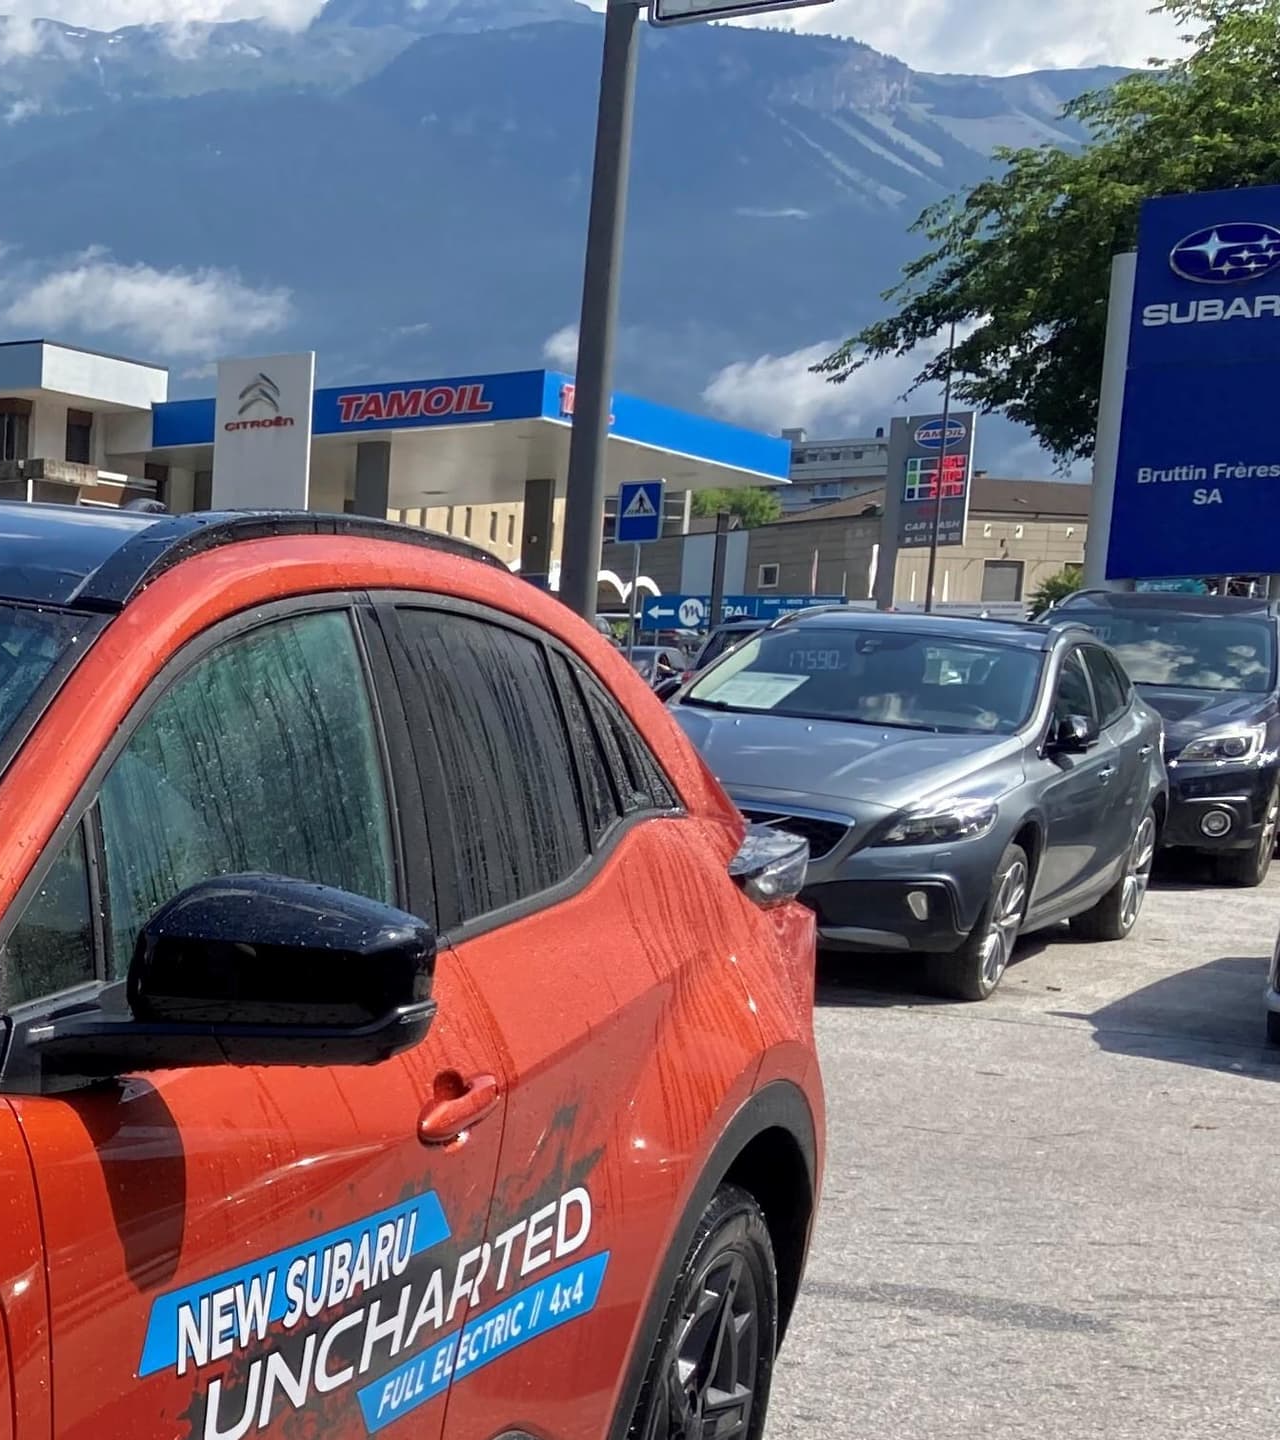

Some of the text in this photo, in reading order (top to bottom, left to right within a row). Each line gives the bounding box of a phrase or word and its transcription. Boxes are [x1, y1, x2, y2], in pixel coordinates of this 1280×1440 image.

[1142, 295, 1280, 327] SUBAR
[338, 384, 493, 422] TAMOIL
[1138, 464, 1207, 483] Bruttin
[1193, 489, 1223, 505] SA
[904, 522, 927, 531] CAR
[176, 1212, 418, 1376] NEW SUBARU
[377, 1361, 424, 1418] FULL
[431, 1301, 523, 1385] ELECTRIC
[550, 1272, 583, 1316] 4x4
